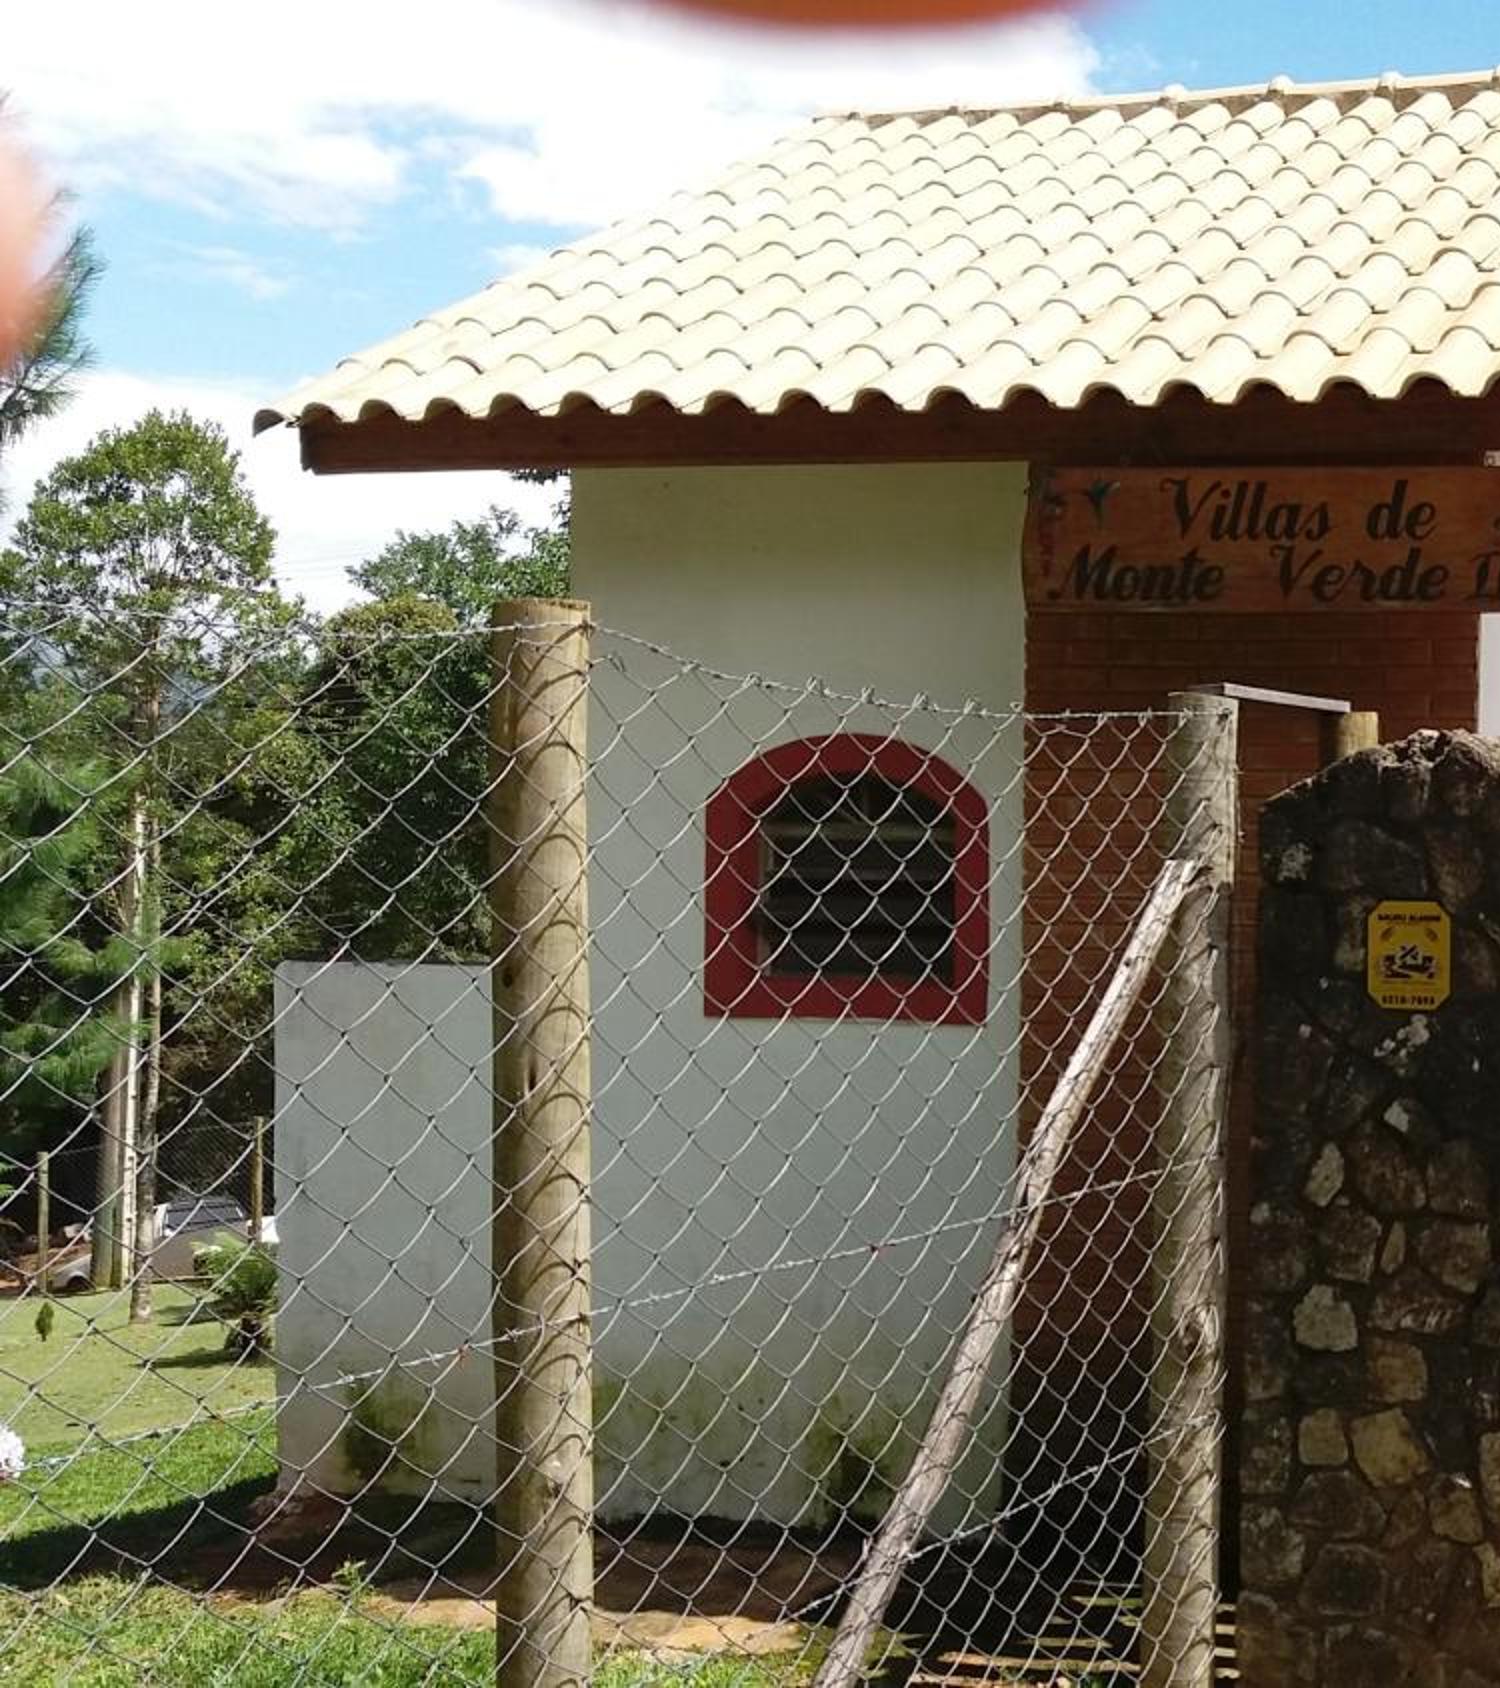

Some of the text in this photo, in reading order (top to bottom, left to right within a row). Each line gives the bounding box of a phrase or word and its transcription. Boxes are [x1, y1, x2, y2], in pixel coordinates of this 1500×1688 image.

[1160, 478, 1436, 542] Villas de
[1048, 544, 1227, 602] Monte
[1270, 544, 1449, 603] Verde
